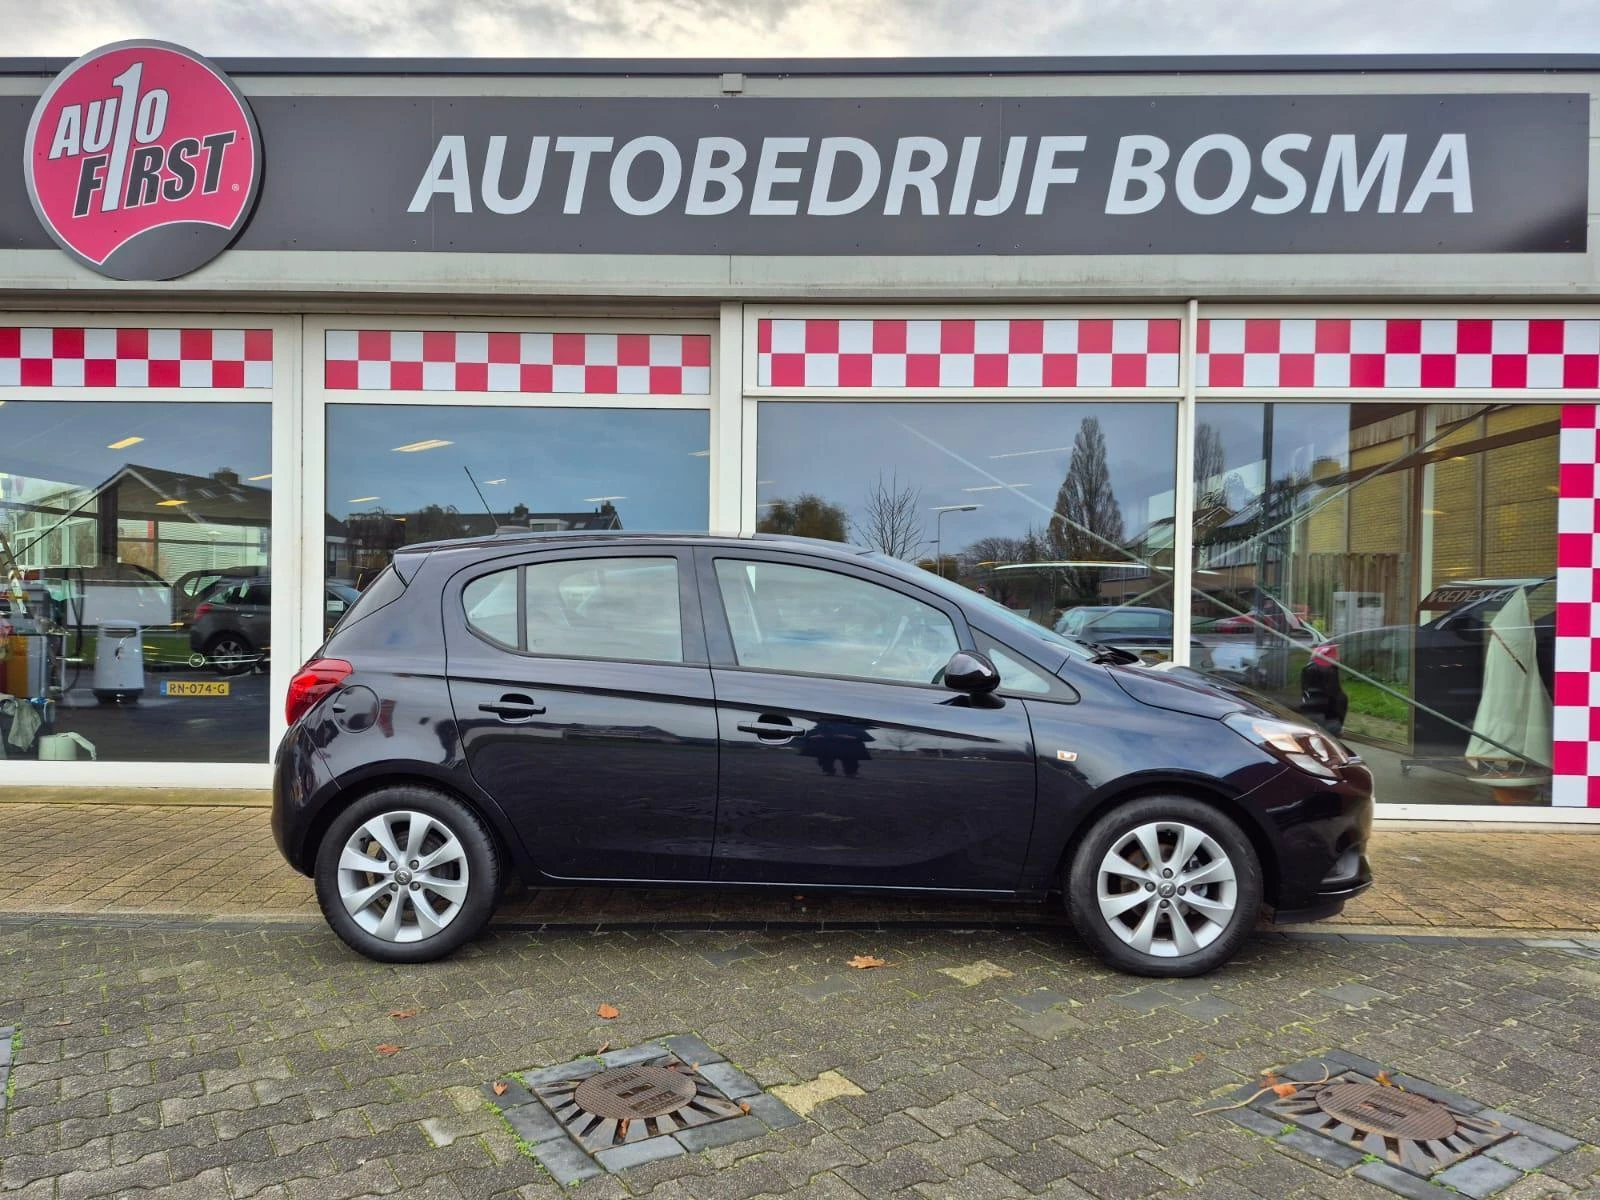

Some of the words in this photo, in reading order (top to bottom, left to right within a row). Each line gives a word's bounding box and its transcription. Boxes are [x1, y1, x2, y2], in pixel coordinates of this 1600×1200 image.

[406, 134, 1087, 217] AUTOBEDRIJF
[1104, 133, 1474, 216] BOSMA
[169, 683, 225, 694] RN-074-G
